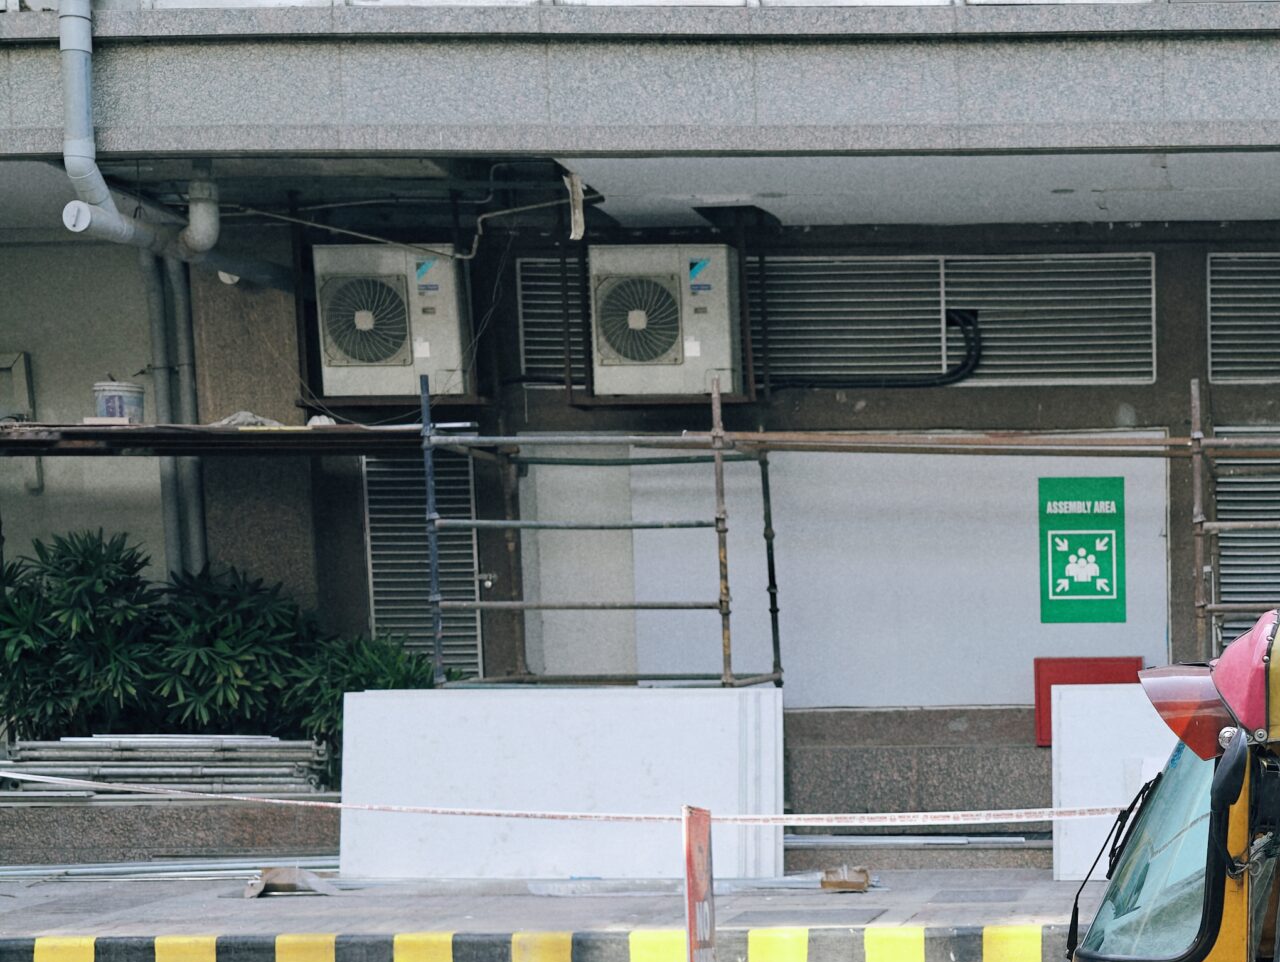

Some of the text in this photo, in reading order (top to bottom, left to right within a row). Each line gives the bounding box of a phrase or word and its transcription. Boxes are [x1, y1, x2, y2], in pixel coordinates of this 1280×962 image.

[1046, 500, 1117, 514] ASSEMBLY AREA
[695, 900, 710, 941] NO
